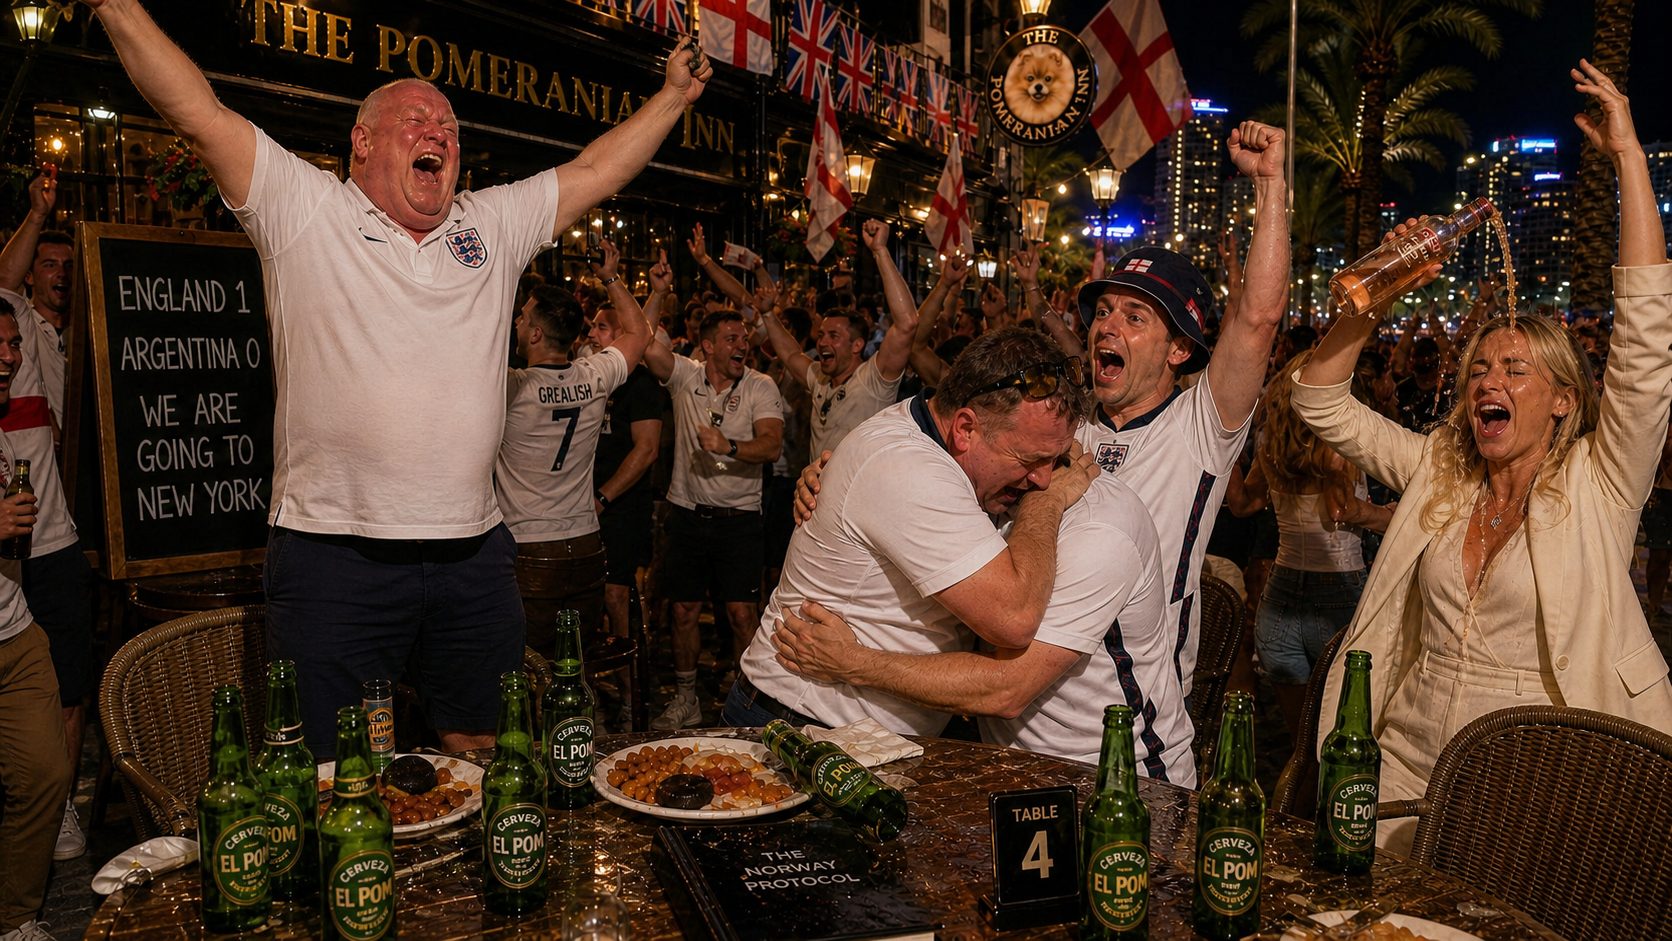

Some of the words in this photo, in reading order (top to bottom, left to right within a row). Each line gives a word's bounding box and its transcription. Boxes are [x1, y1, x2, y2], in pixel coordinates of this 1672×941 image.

[1022, 29, 1059, 46] THE
[240, 0, 354, 64] THE
[376, 24, 651, 127] POMERANIA
[680, 104, 736, 154] INN
[990, 74, 1081, 140] POMERANIAN
[118, 275, 226, 313] ENGLAND
[235, 280, 251, 314] 1
[121, 336, 241, 371] ARGENTINA
[538, 383, 593, 404] GREALISH
[139, 394, 180, 428] WE
[194, 392, 241, 425] ARE
[550, 406, 582, 472] 7
[137, 436, 214, 472] GOING
[222, 434, 254, 466] TO
[137, 483, 195, 521] NEW
[203, 477, 266, 515] YORK
[553, 744, 568, 760] EL
[265, 803, 290, 821] VEZA
[497, 813, 541, 832] CERVEZA
[1012, 804, 1059, 822] TABLE
[1333, 801, 1350, 820] EL
[224, 825, 266, 849] CERVE
[493, 835, 509, 855] EL
[512, 831, 544, 855] POM
[1208, 837, 1256, 857] CERVEZA
[220, 854, 240, 873] EL
[761, 850, 806, 861] THE
[1021, 829, 1054, 879] 4
[1100, 851, 1146, 870] CERVEZA
[339, 859, 390, 884] CERVEZA
[744, 859, 836, 877] NORWAY
[1203, 855, 1220, 878] EL
[1223, 859, 1258, 881] POM
[335, 887, 355, 908] EL
[358, 877, 393, 908] POM
[745, 873, 861, 892] PROTOCOL
[1094, 872, 1112, 895] EL
[1115, 871, 1148, 896] POM
